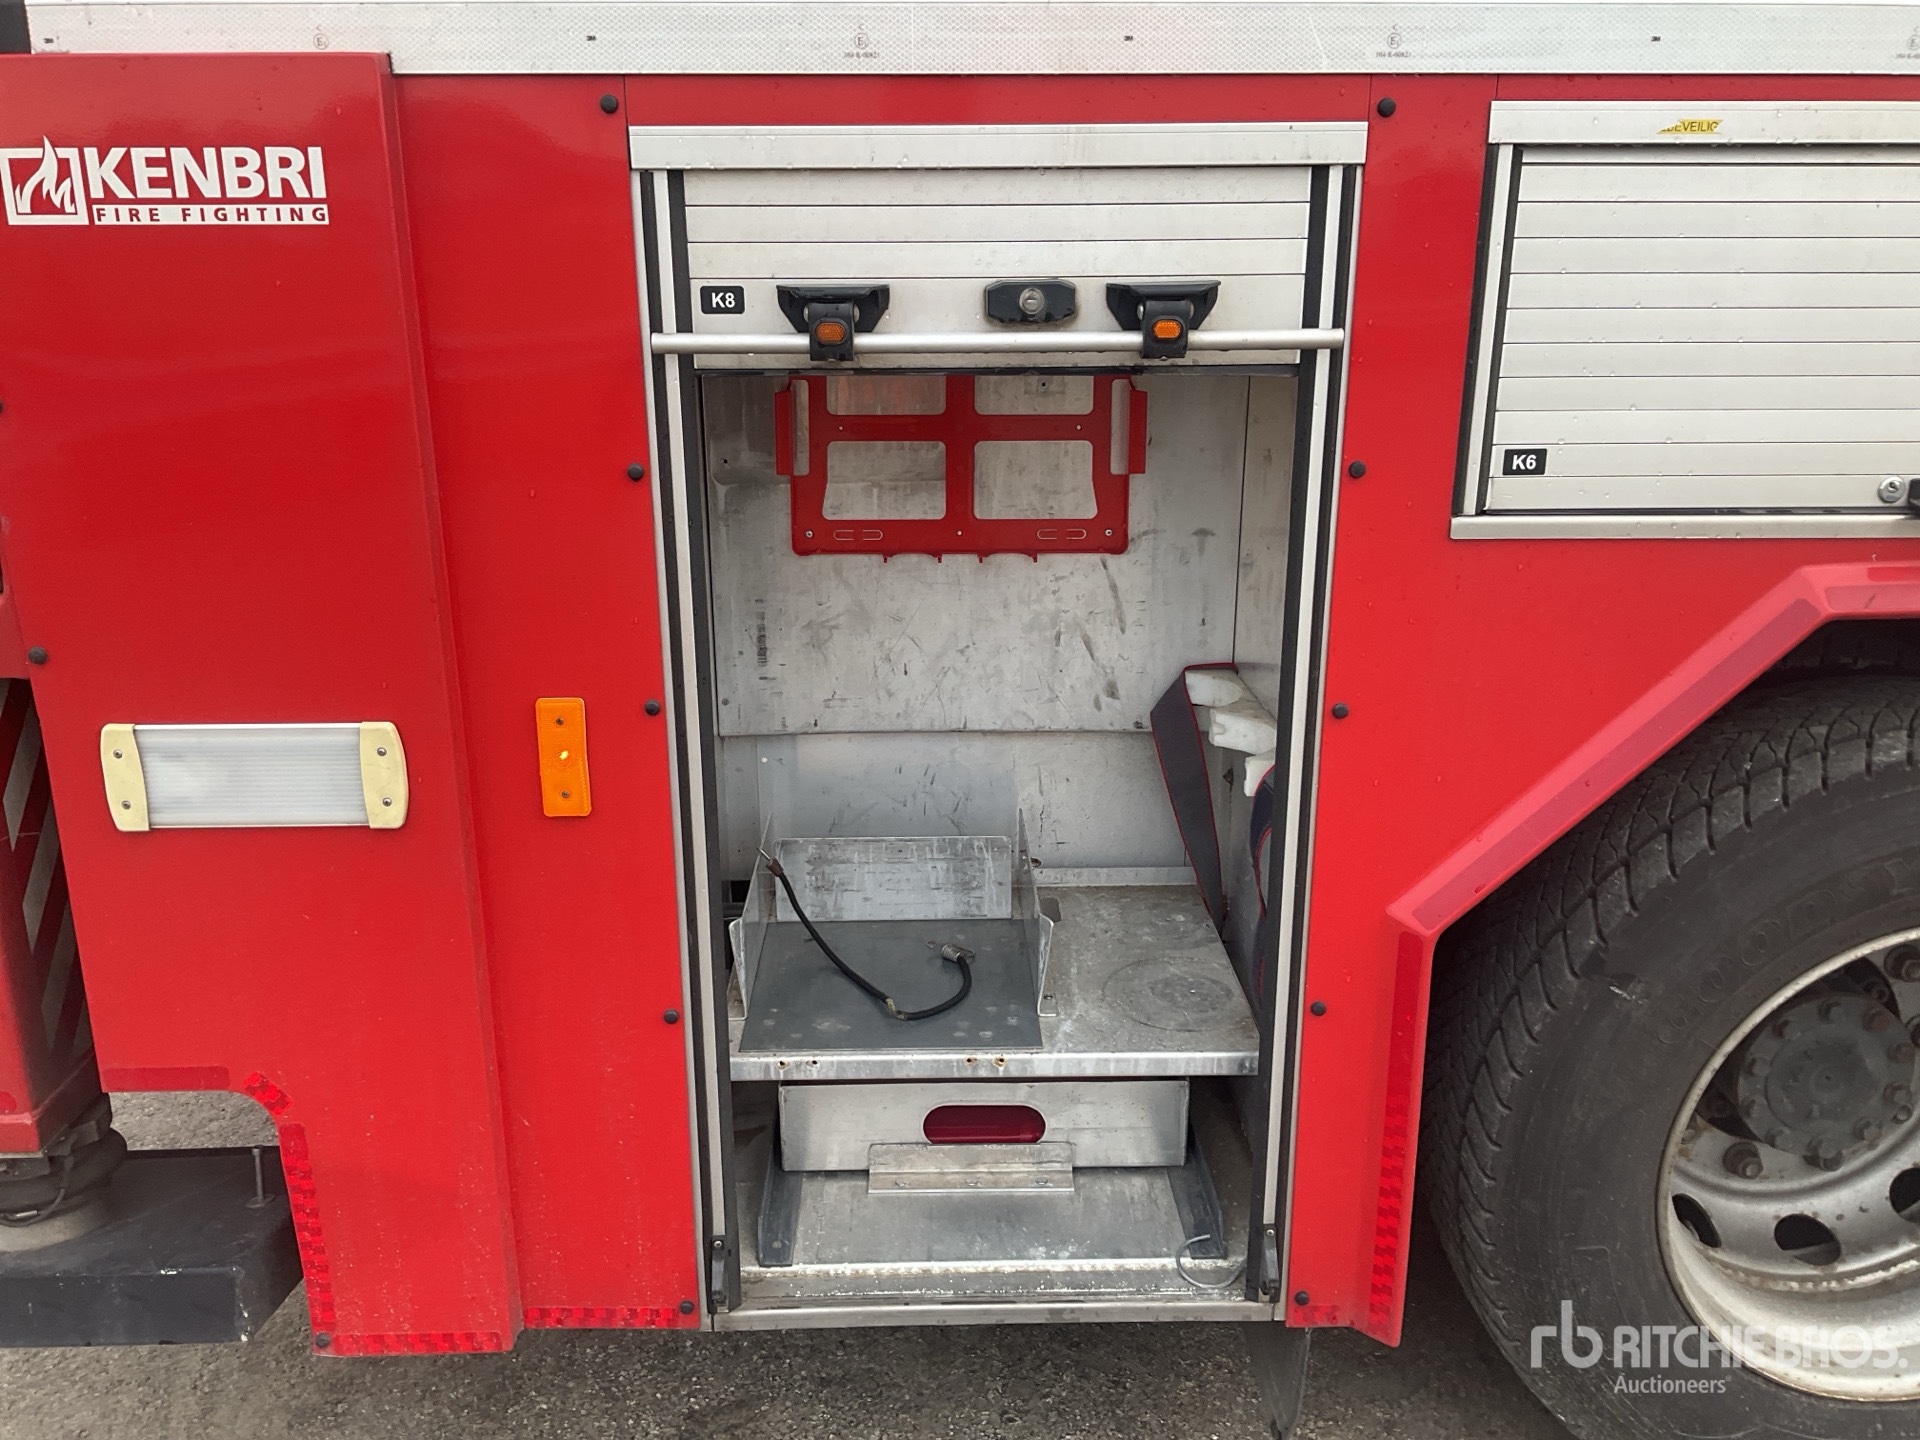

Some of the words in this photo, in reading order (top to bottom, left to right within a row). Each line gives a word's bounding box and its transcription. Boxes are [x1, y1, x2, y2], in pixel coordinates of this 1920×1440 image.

[83, 146, 327, 199] KENBRI
[96, 207, 160, 222] FIRE
[181, 207, 326, 222] FIGHTING
[711, 292, 735, 308] K8
[1512, 454, 1537, 470] K6
